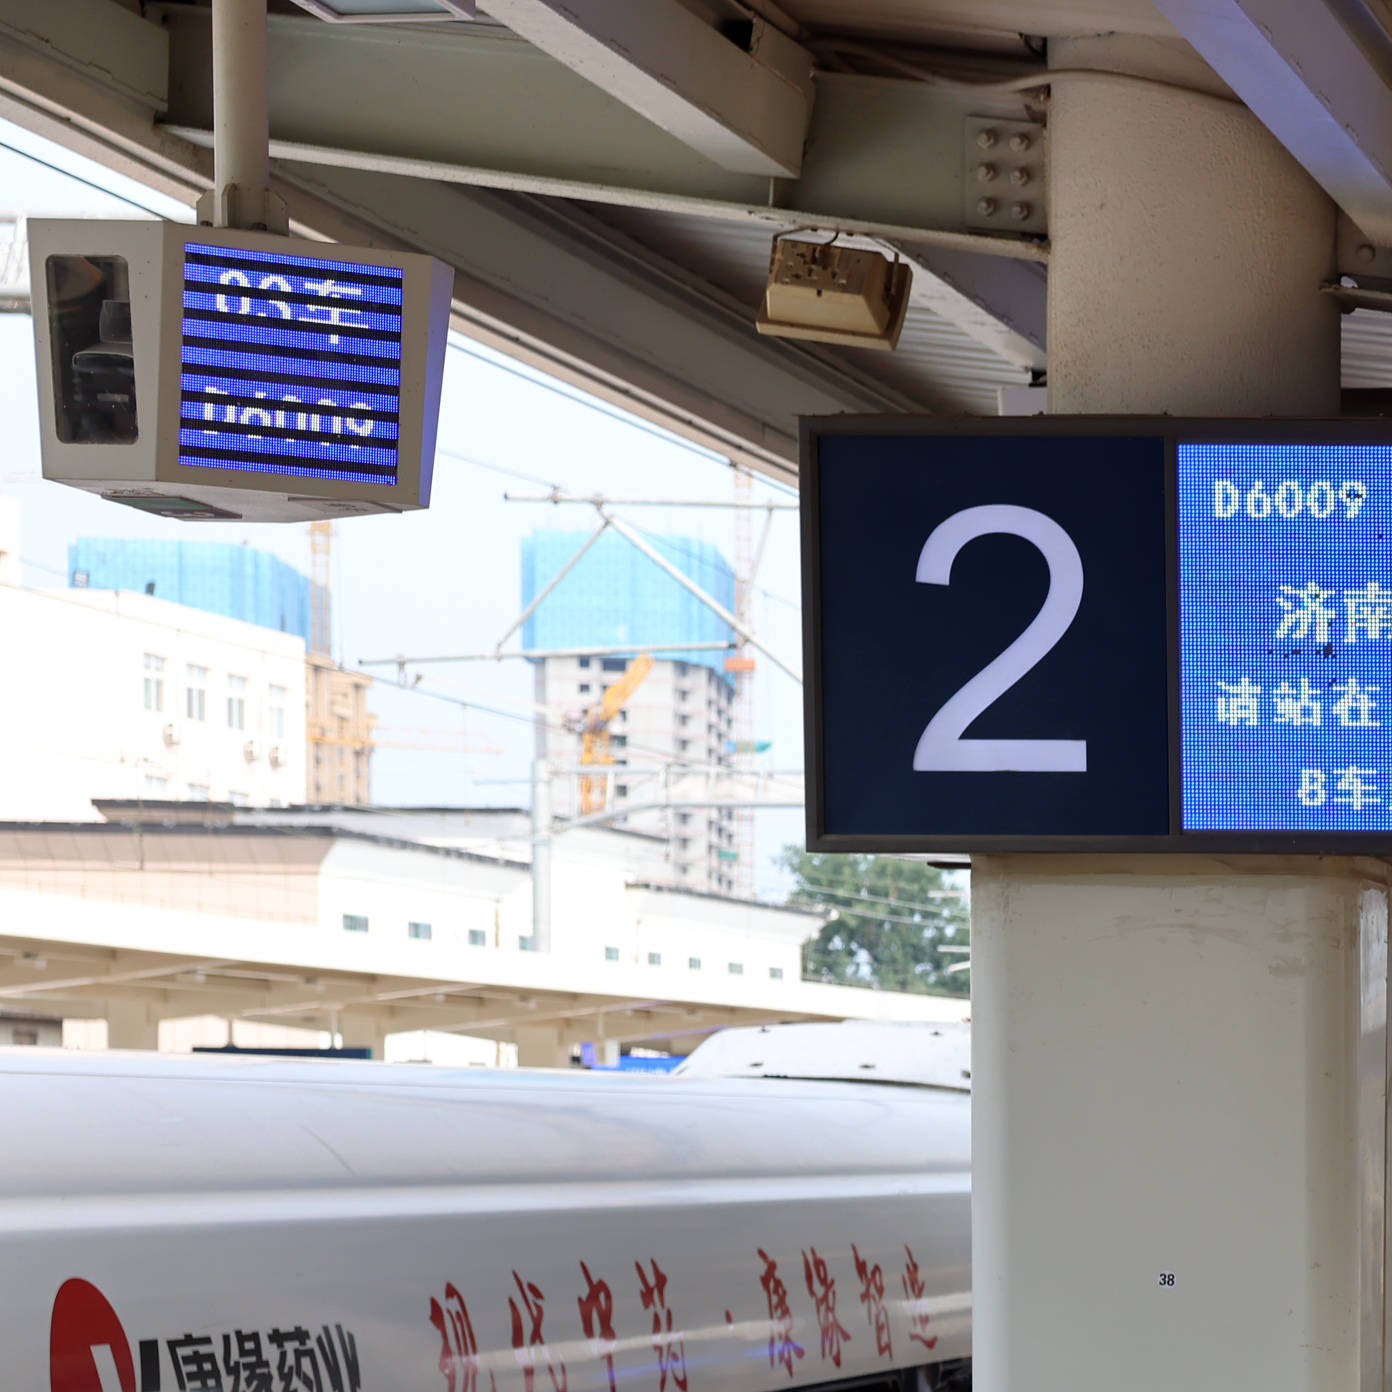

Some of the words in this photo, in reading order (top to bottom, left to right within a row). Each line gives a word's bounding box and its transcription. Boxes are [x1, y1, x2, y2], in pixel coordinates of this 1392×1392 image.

[1214, 479, 1367, 519] D6009
[912, 502, 1088, 772] 2
[1158, 1272, 1176, 1287] 38
